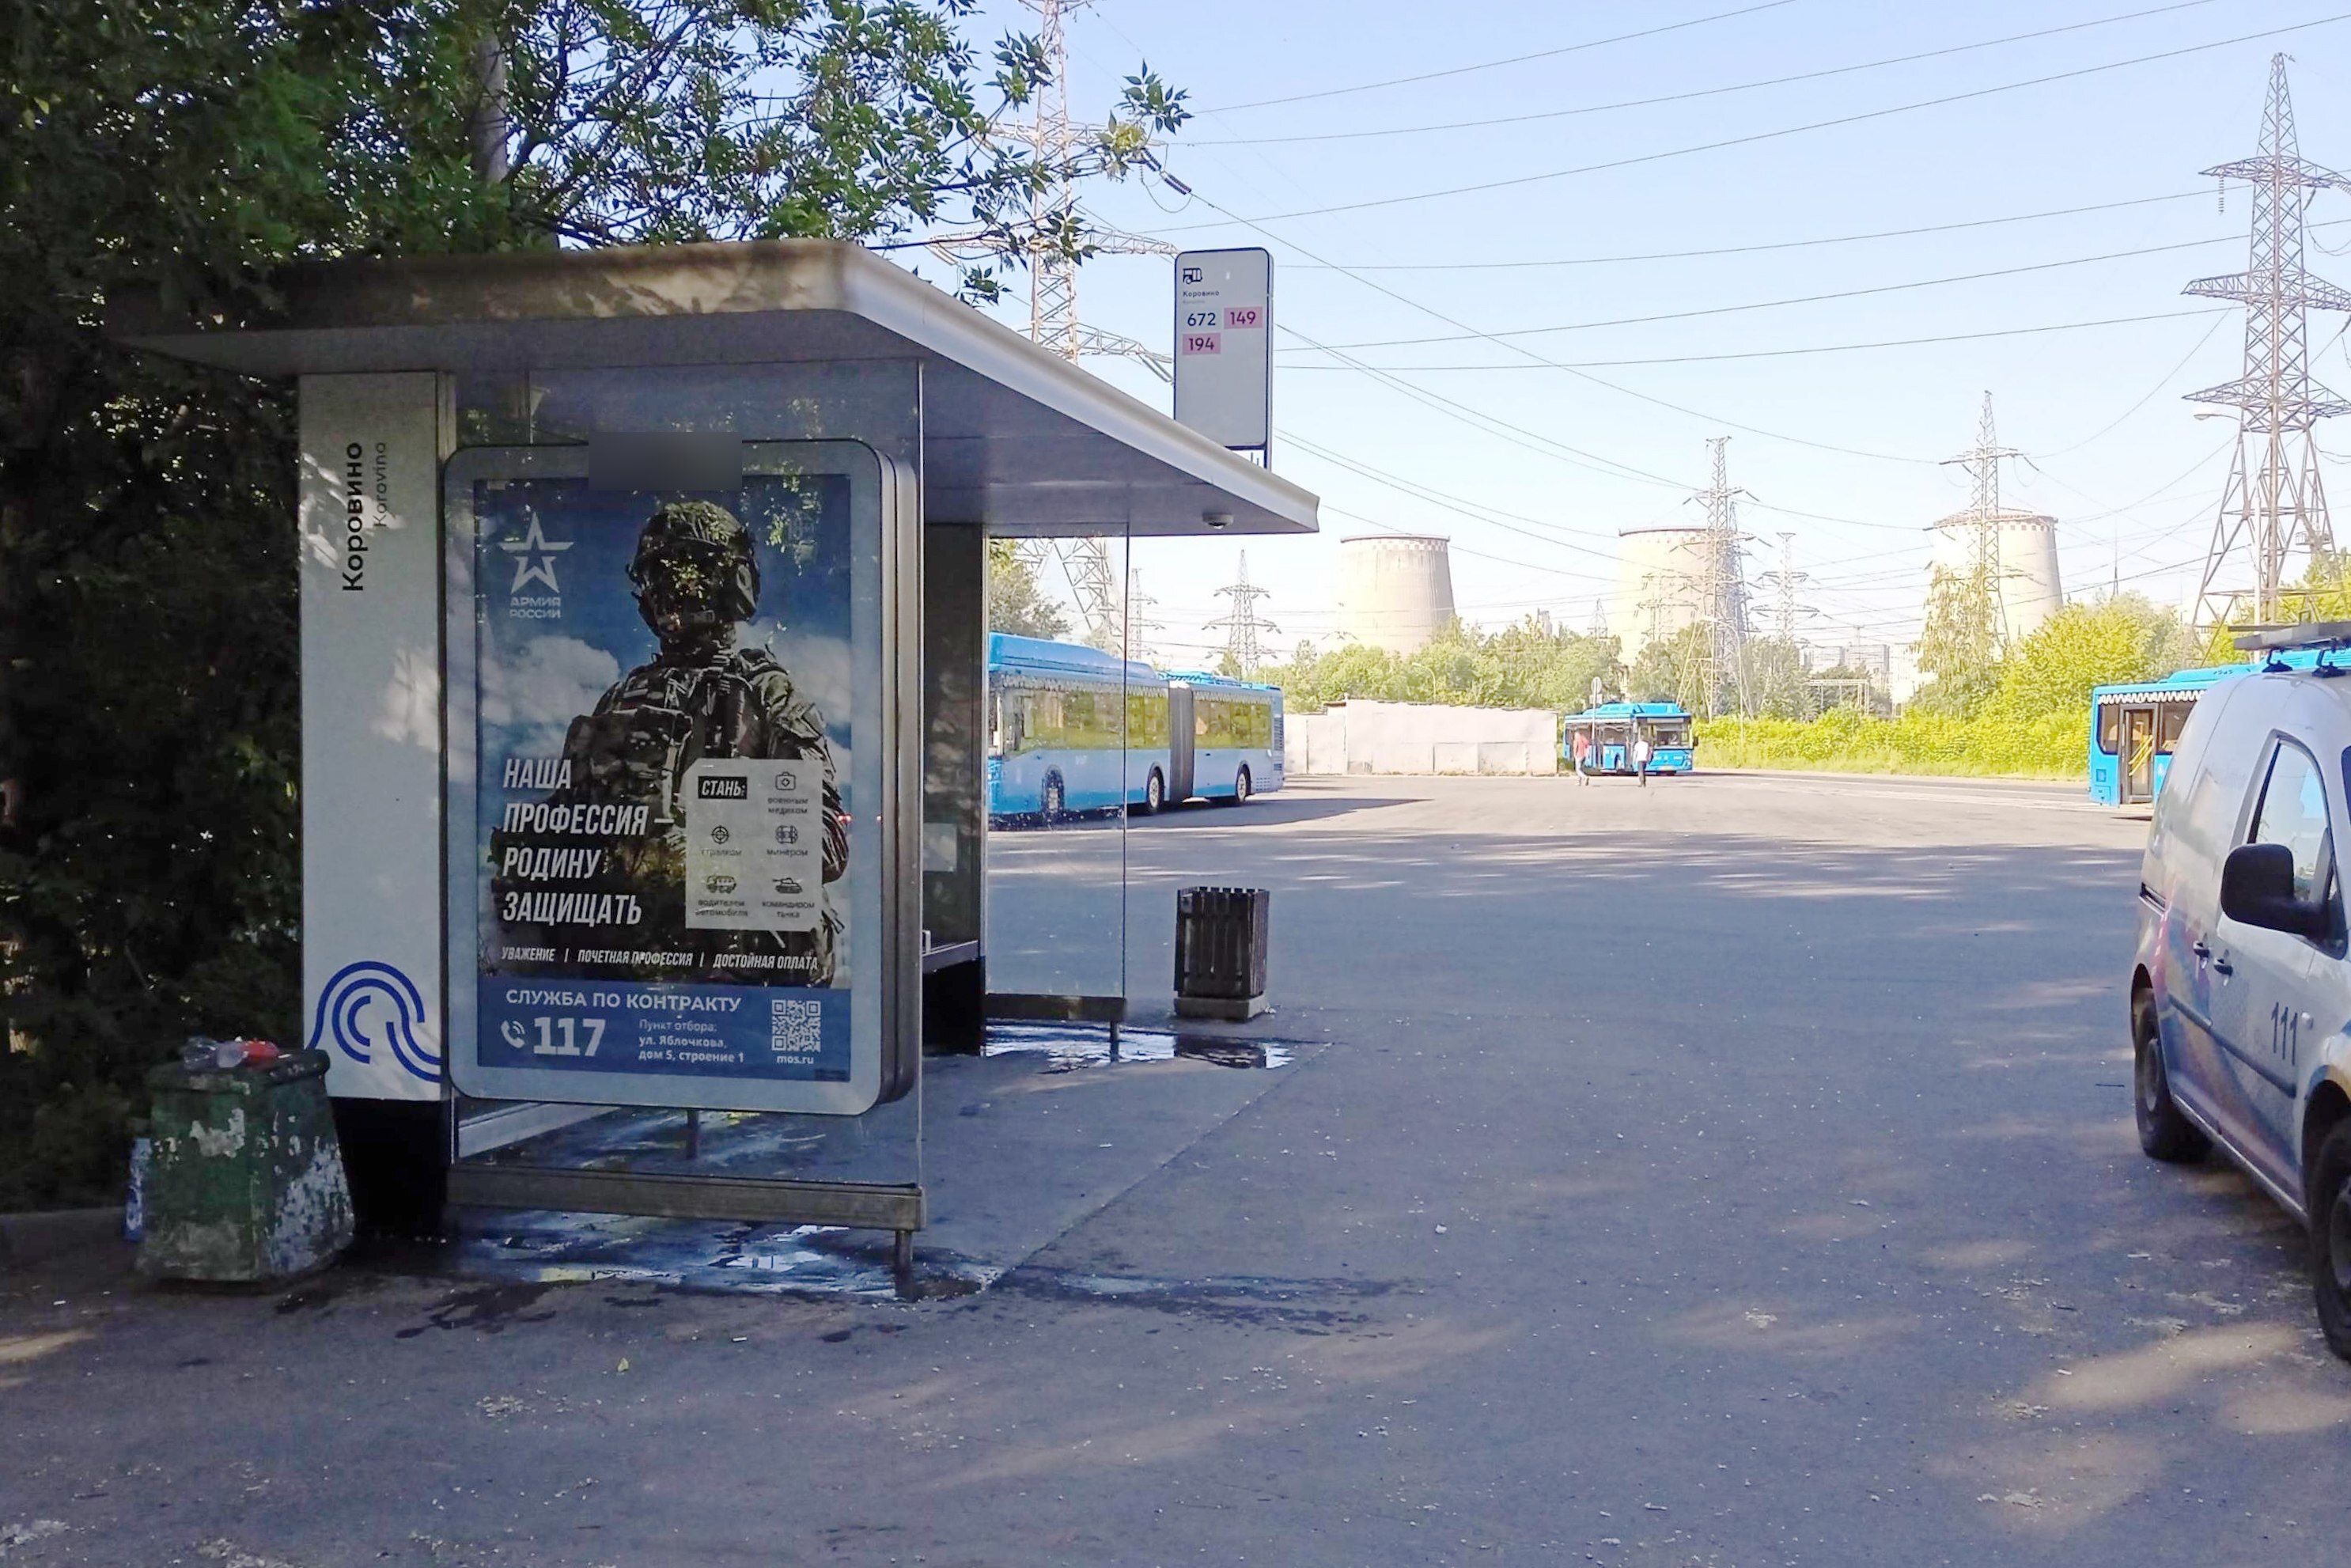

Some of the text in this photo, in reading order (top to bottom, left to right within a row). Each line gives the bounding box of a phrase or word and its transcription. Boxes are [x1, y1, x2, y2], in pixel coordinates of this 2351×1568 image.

[1187, 311, 1256, 326] 672 149
[1189, 337, 1214, 350] 194
[372, 442, 387, 527] Korovino
[342, 442, 369, 591] Коровино
[510, 597, 561, 607] АРМИЯ
[509, 609, 561, 619] РОССИИ
[503, 759, 571, 789] НАША
[702, 779, 746, 796] СТАНЬ:
[503, 803, 649, 835] ПРОФЕССИЯ
[502, 847, 601, 881] РОДИНУ
[502, 892, 642, 927] ЗАЩИЩАТЬ
[502, 947, 818, 971] УВАЖЕНИЕ ПОЧЕТНАЯ ПРОФЕССИЯ ДОСТОЙНАЯ ОПЛАТА
[505, 990, 741, 1012] СЛУЖБА ПО КОНТРАКТУ
[533, 1017, 606, 1056] 117
[639, 1019, 717, 1033] Пункт отбора:
[2270, 1002, 2298, 1066] 111
[639, 1035, 727, 1048] ул. Яблочкова,
[638, 1050, 744, 1063] дом 5, строение 1
[776, 1055, 814, 1065] mos.ru
